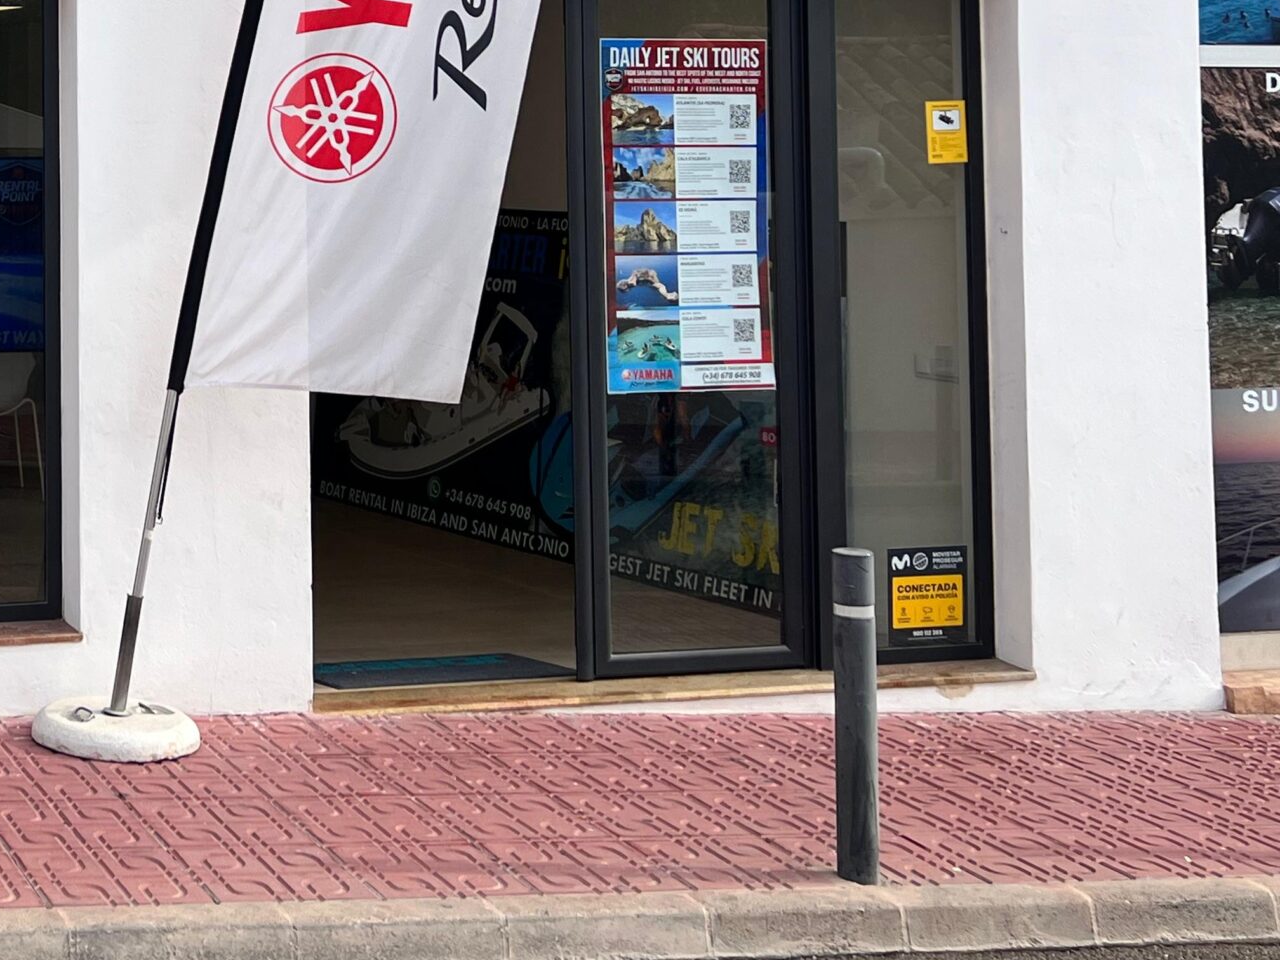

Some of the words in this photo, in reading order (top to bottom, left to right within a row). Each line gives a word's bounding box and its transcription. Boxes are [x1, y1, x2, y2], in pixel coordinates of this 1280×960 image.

[609, 47, 651, 68] DAILY
[654, 47, 680, 68] JET
[683, 47, 708, 68] SKI
[712, 48, 760, 68] TOURS
[1265, 72, 1280, 93] D
[0, 191, 37, 203] POINT
[497, 214, 529, 229] TONIO
[536, 217, 549, 231] LA
[551, 217, 568, 232] FLO
[495, 232, 550, 274] RTER
[633, 369, 673, 380] YAMAHA
[1242, 389, 1278, 413] SU
[320, 479, 347, 499] BOAT
[348, 487, 388, 511] RENTAL
[390, 497, 404, 516] IN
[407, 502, 437, 525] IBIZA
[439, 512, 468, 533] AND
[471, 519, 498, 540] SAN
[445, 488, 464, 503] +34
[464, 490, 485, 510] 678
[486, 496, 507, 515] 645
[509, 502, 532, 521] 908
[657, 501, 726, 558] JET
[609, 552, 643, 577] GEST
[646, 561, 672, 584] JET
[674, 569, 699, 591] SKI
[703, 575, 749, 604] FLEET
[752, 587, 773, 609] IN
[897, 582, 958, 594] CONECTADA
